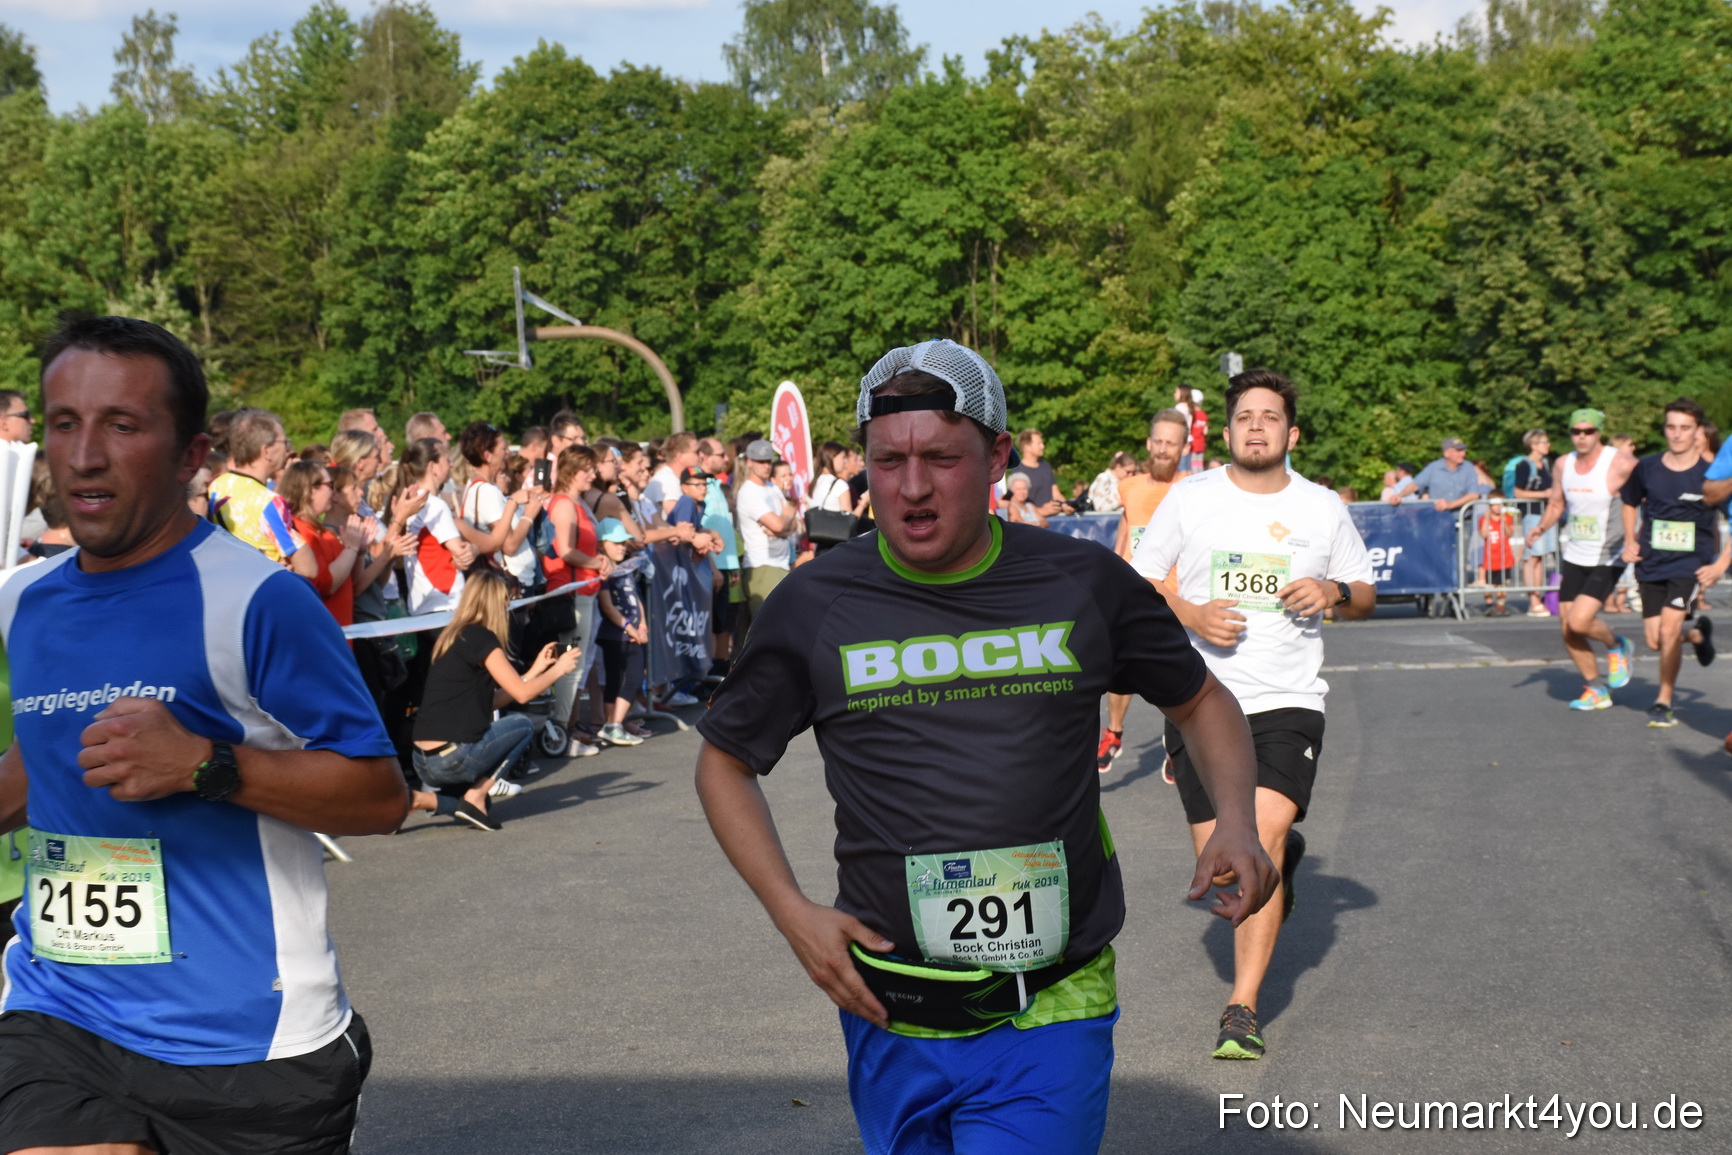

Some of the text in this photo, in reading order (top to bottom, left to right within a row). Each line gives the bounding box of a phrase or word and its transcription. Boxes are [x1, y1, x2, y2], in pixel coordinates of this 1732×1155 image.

[1658, 531, 1689, 543] 1412
[1220, 571, 1279, 595] 1368
[846, 628, 1073, 687] BOCK
[12, 681, 177, 715] nergiegeladen
[847, 677, 1074, 713] inspired by smart concepts
[121, 872, 151, 882] 2019
[933, 873, 997, 890] firmenlauf
[1034, 875, 1059, 889] 2019
[39, 878, 142, 928] 2155
[946, 891, 1034, 940] 291
[56, 927, 116, 941] Ott Markus
[953, 938, 1041, 953] Bock Christian
[952, 954, 973, 962] Bock
[981, 954, 1007, 962] GmbH
[1009, 952, 1016, 960] &
[1017, 951, 1032, 960] Co.
[1033, 948, 1044, 957] KG
